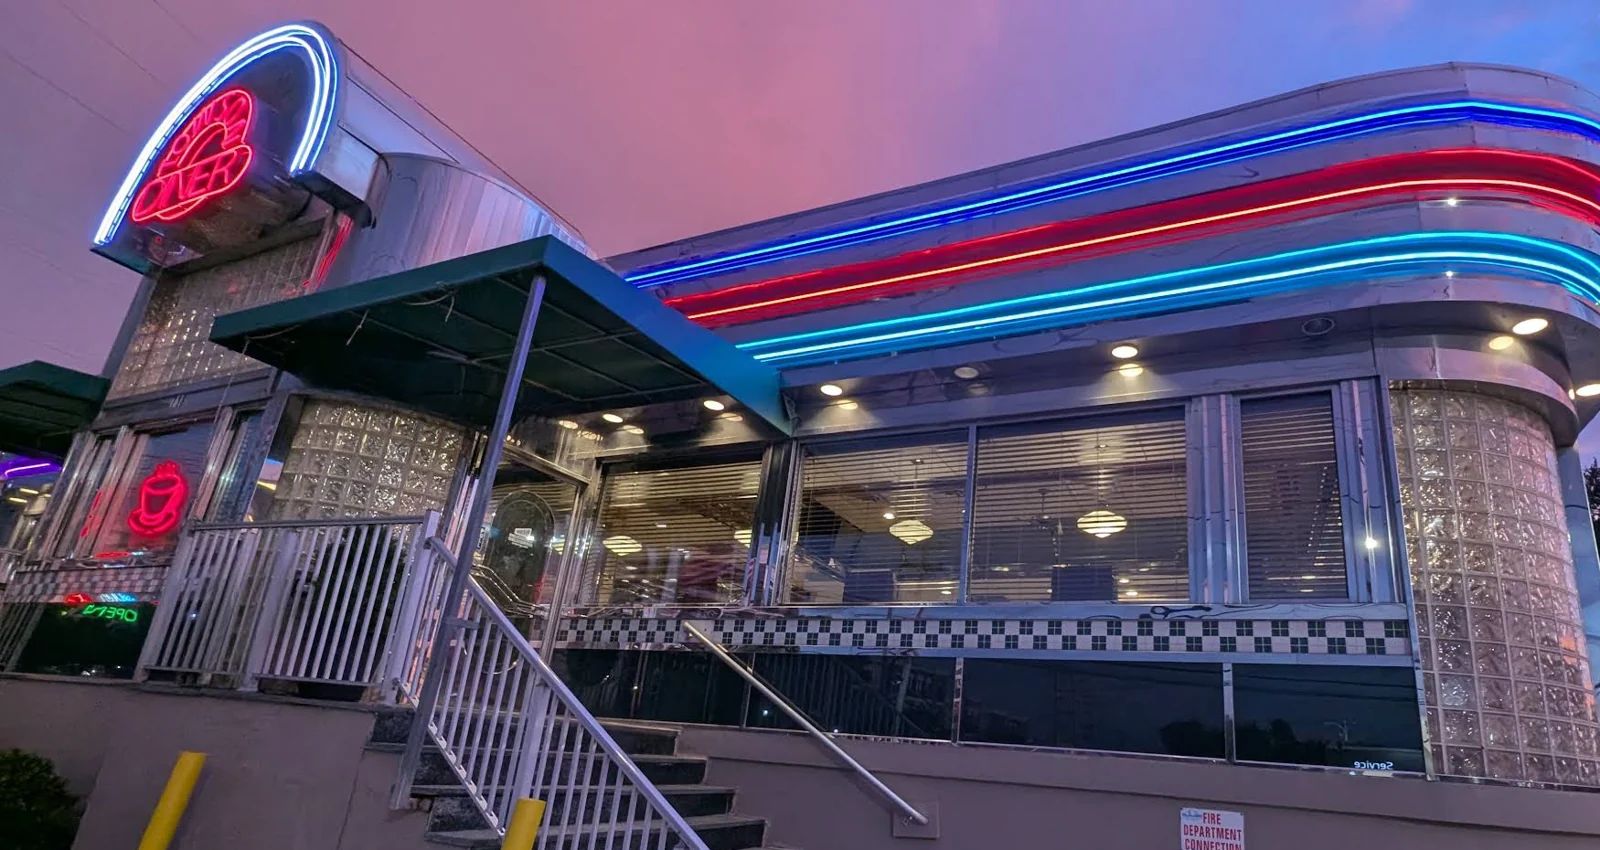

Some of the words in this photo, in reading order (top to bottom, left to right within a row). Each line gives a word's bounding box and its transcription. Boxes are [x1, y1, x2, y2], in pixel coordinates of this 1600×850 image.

[134, 151, 238, 216] DINER
[1203, 812, 1222, 825] FIRE
[1184, 824, 1242, 841] DEPARTMENT
[1185, 839, 1242, 850] CONNECTION
